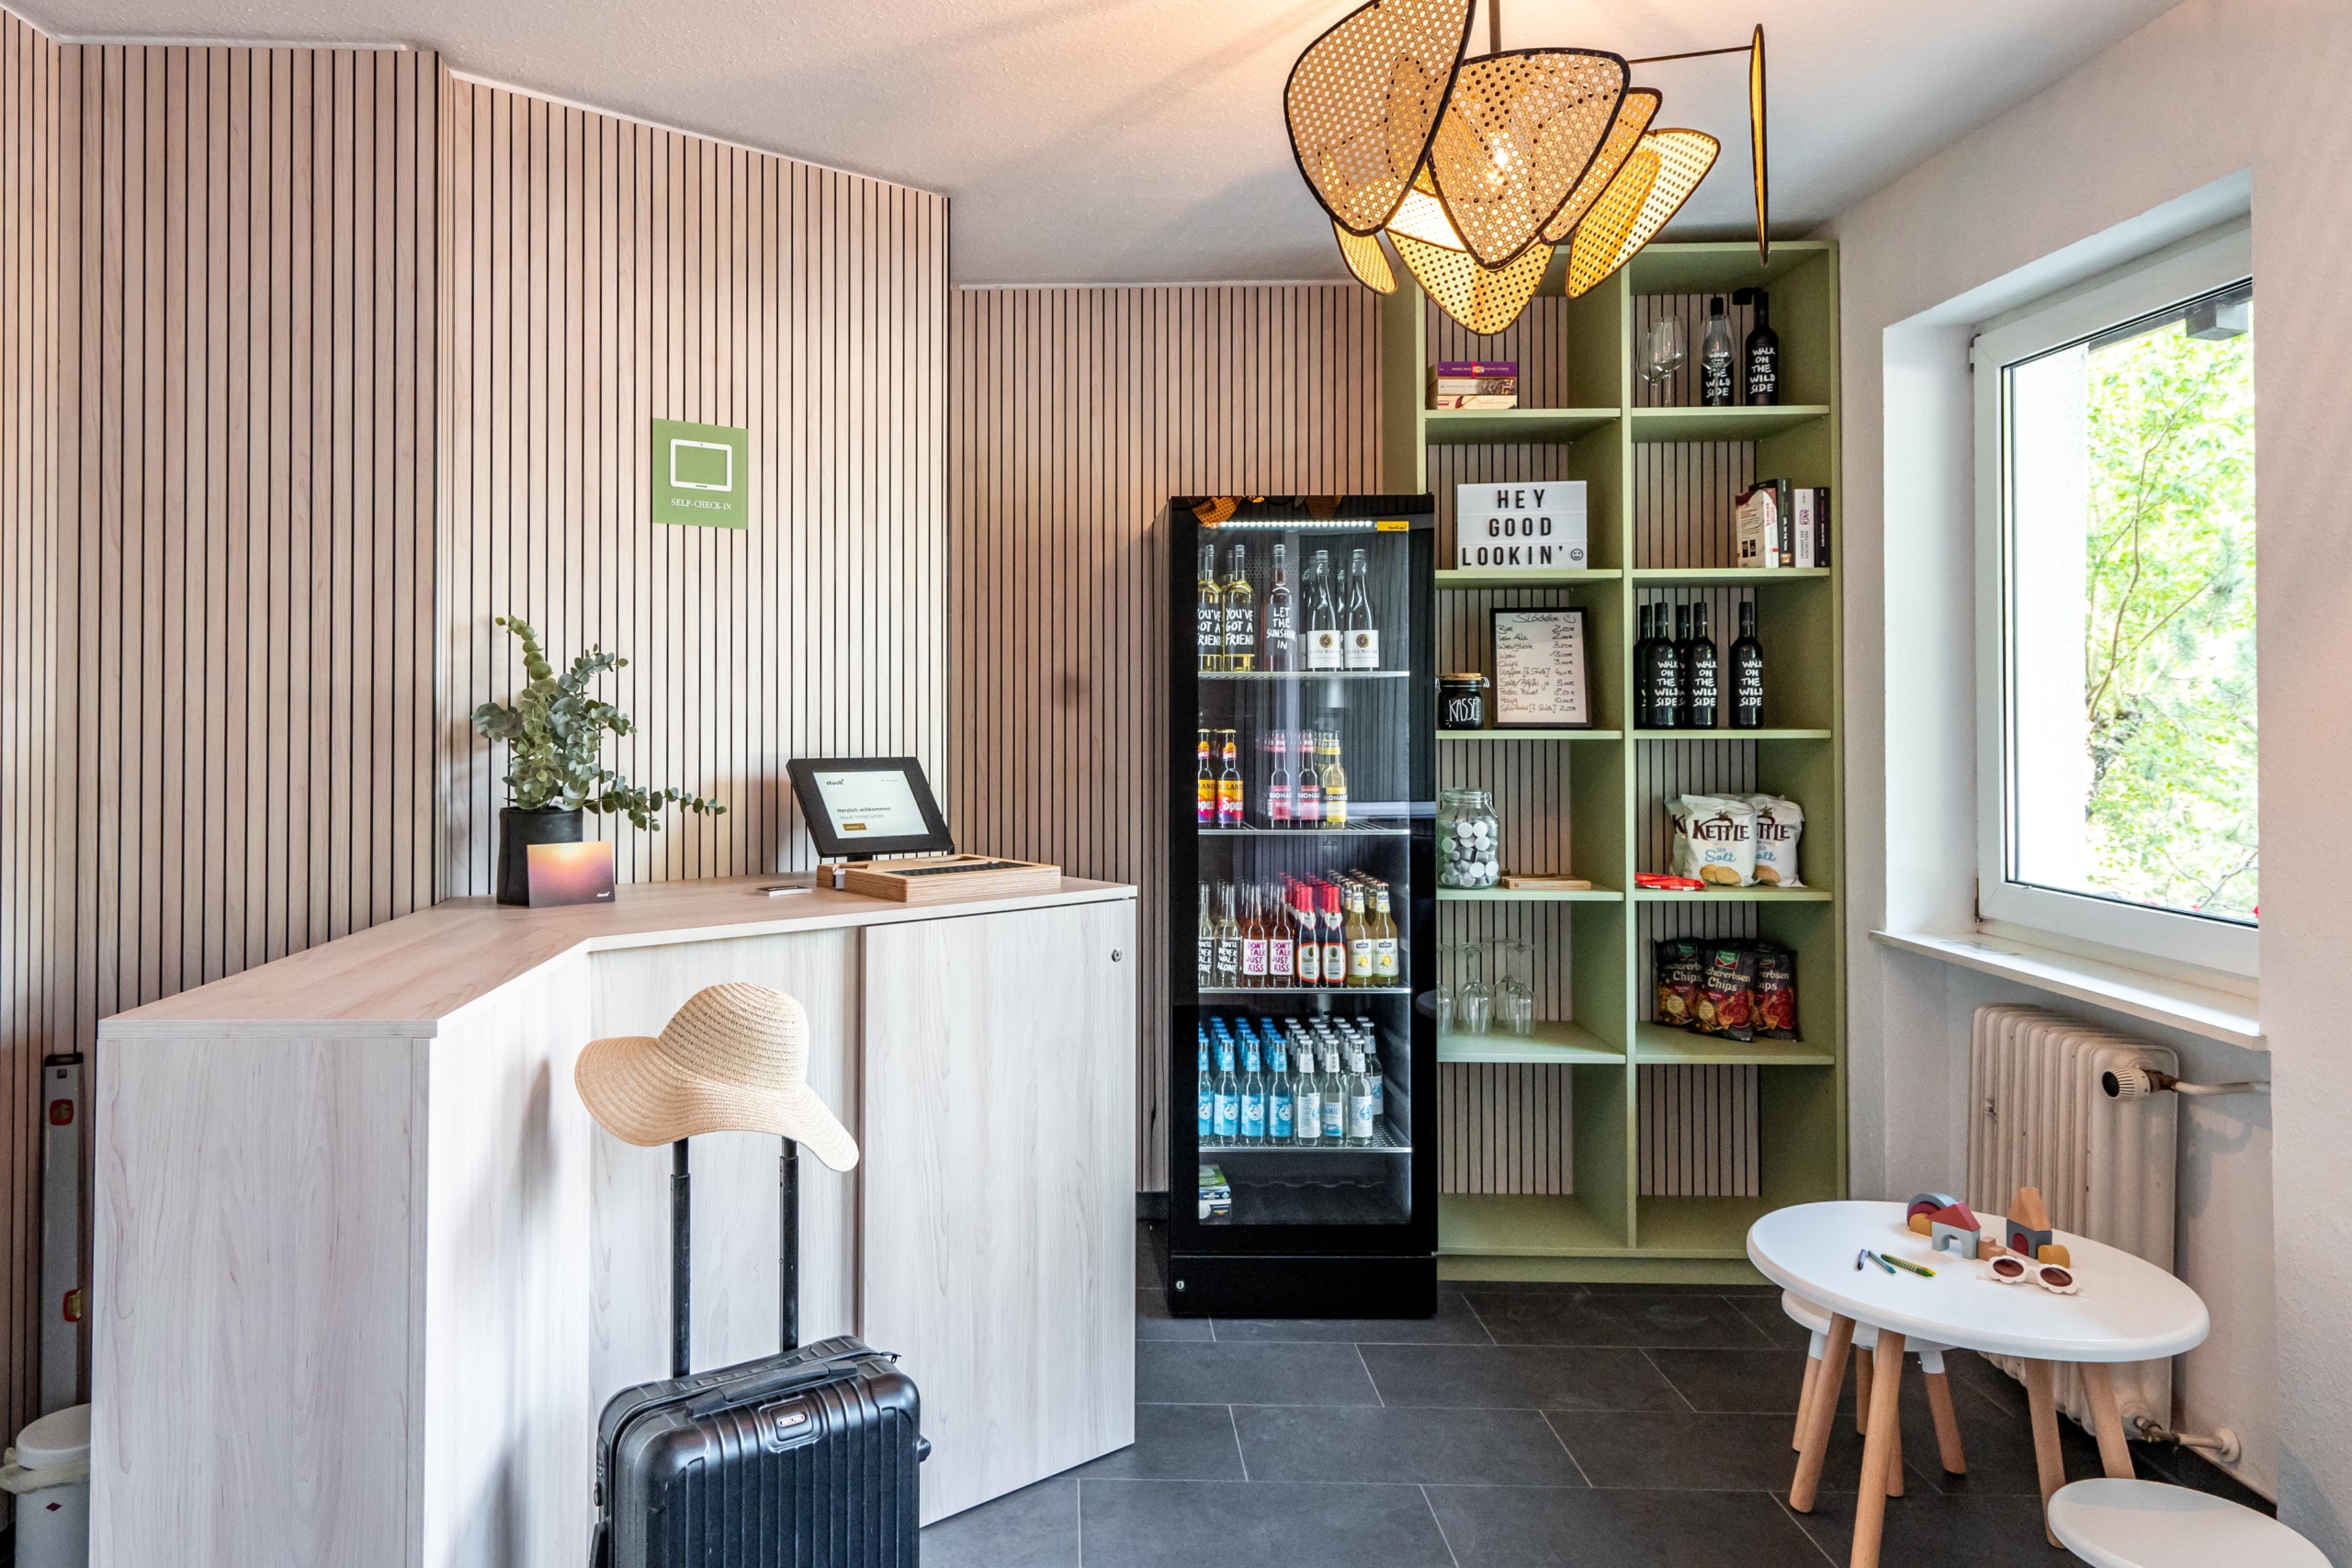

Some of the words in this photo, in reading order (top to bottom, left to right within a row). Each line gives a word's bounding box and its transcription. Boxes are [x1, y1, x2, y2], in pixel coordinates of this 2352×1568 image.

[1752, 347, 1776, 355] WALK
[1755, 355, 1769, 364] ON
[1751, 365, 1772, 373] THE
[1706, 378, 1731, 388] WLD
[1749, 375, 1776, 383] WILD
[1749, 383, 1774, 394] SIDE
[671, 498, 731, 510] SELF-CHECK-IN
[1498, 489, 1545, 509] HEY
[1489, 517, 1552, 536] GOOD
[1198, 608, 1221, 622] OU'VE
[1226, 608, 1253, 621] YOU'VE
[1273, 607, 1290, 617] LET
[1215, 623, 1220, 633] A
[1226, 621, 1243, 632] GOT
[1247, 623, 1253, 633] A
[1272, 618, 1291, 628] THE
[1267, 628, 1295, 641] SUNSHIN
[1277, 640, 1287, 649] IN
[1498, 660, 1518, 669] Chips
[1657, 660, 1678, 669] WALK
[1696, 660, 1717, 669] WALK
[1498, 668, 1522, 678] Kaffee
[1745, 669, 1758, 677] ON
[1657, 678, 1676, 686] THE
[1694, 678, 1714, 686] THE
[1740, 678, 1761, 686] THE
[1655, 688, 1678, 696] WILD
[1692, 688, 1717, 696] WILD
[1739, 688, 1763, 696] WILD
[1500, 696, 1518, 706] Honig
[1655, 697, 1678, 706] SIDE
[1692, 697, 1716, 706] SIDE
[1739, 696, 1762, 706] SIDE
[1449, 696, 1480, 722] KASSE
[1692, 819, 1749, 841] KETTLE
[1757, 818, 1791, 841] TTLE
[1704, 850, 1736, 863] Salt
[1756, 852, 1776, 862] alt
[1198, 948, 1212, 957] EVER
[1218, 947, 1238, 957] NEVER
[1199, 964, 1212, 974] ONE
[1217, 963, 1237, 974] ALONE
[1274, 964, 1289, 972] KISS
[1673, 971, 1702, 984] Chips
[1706, 967, 1750, 983] chererbsen
[1708, 976, 1737, 992] Chips
[1758, 980, 1778, 991] ips
